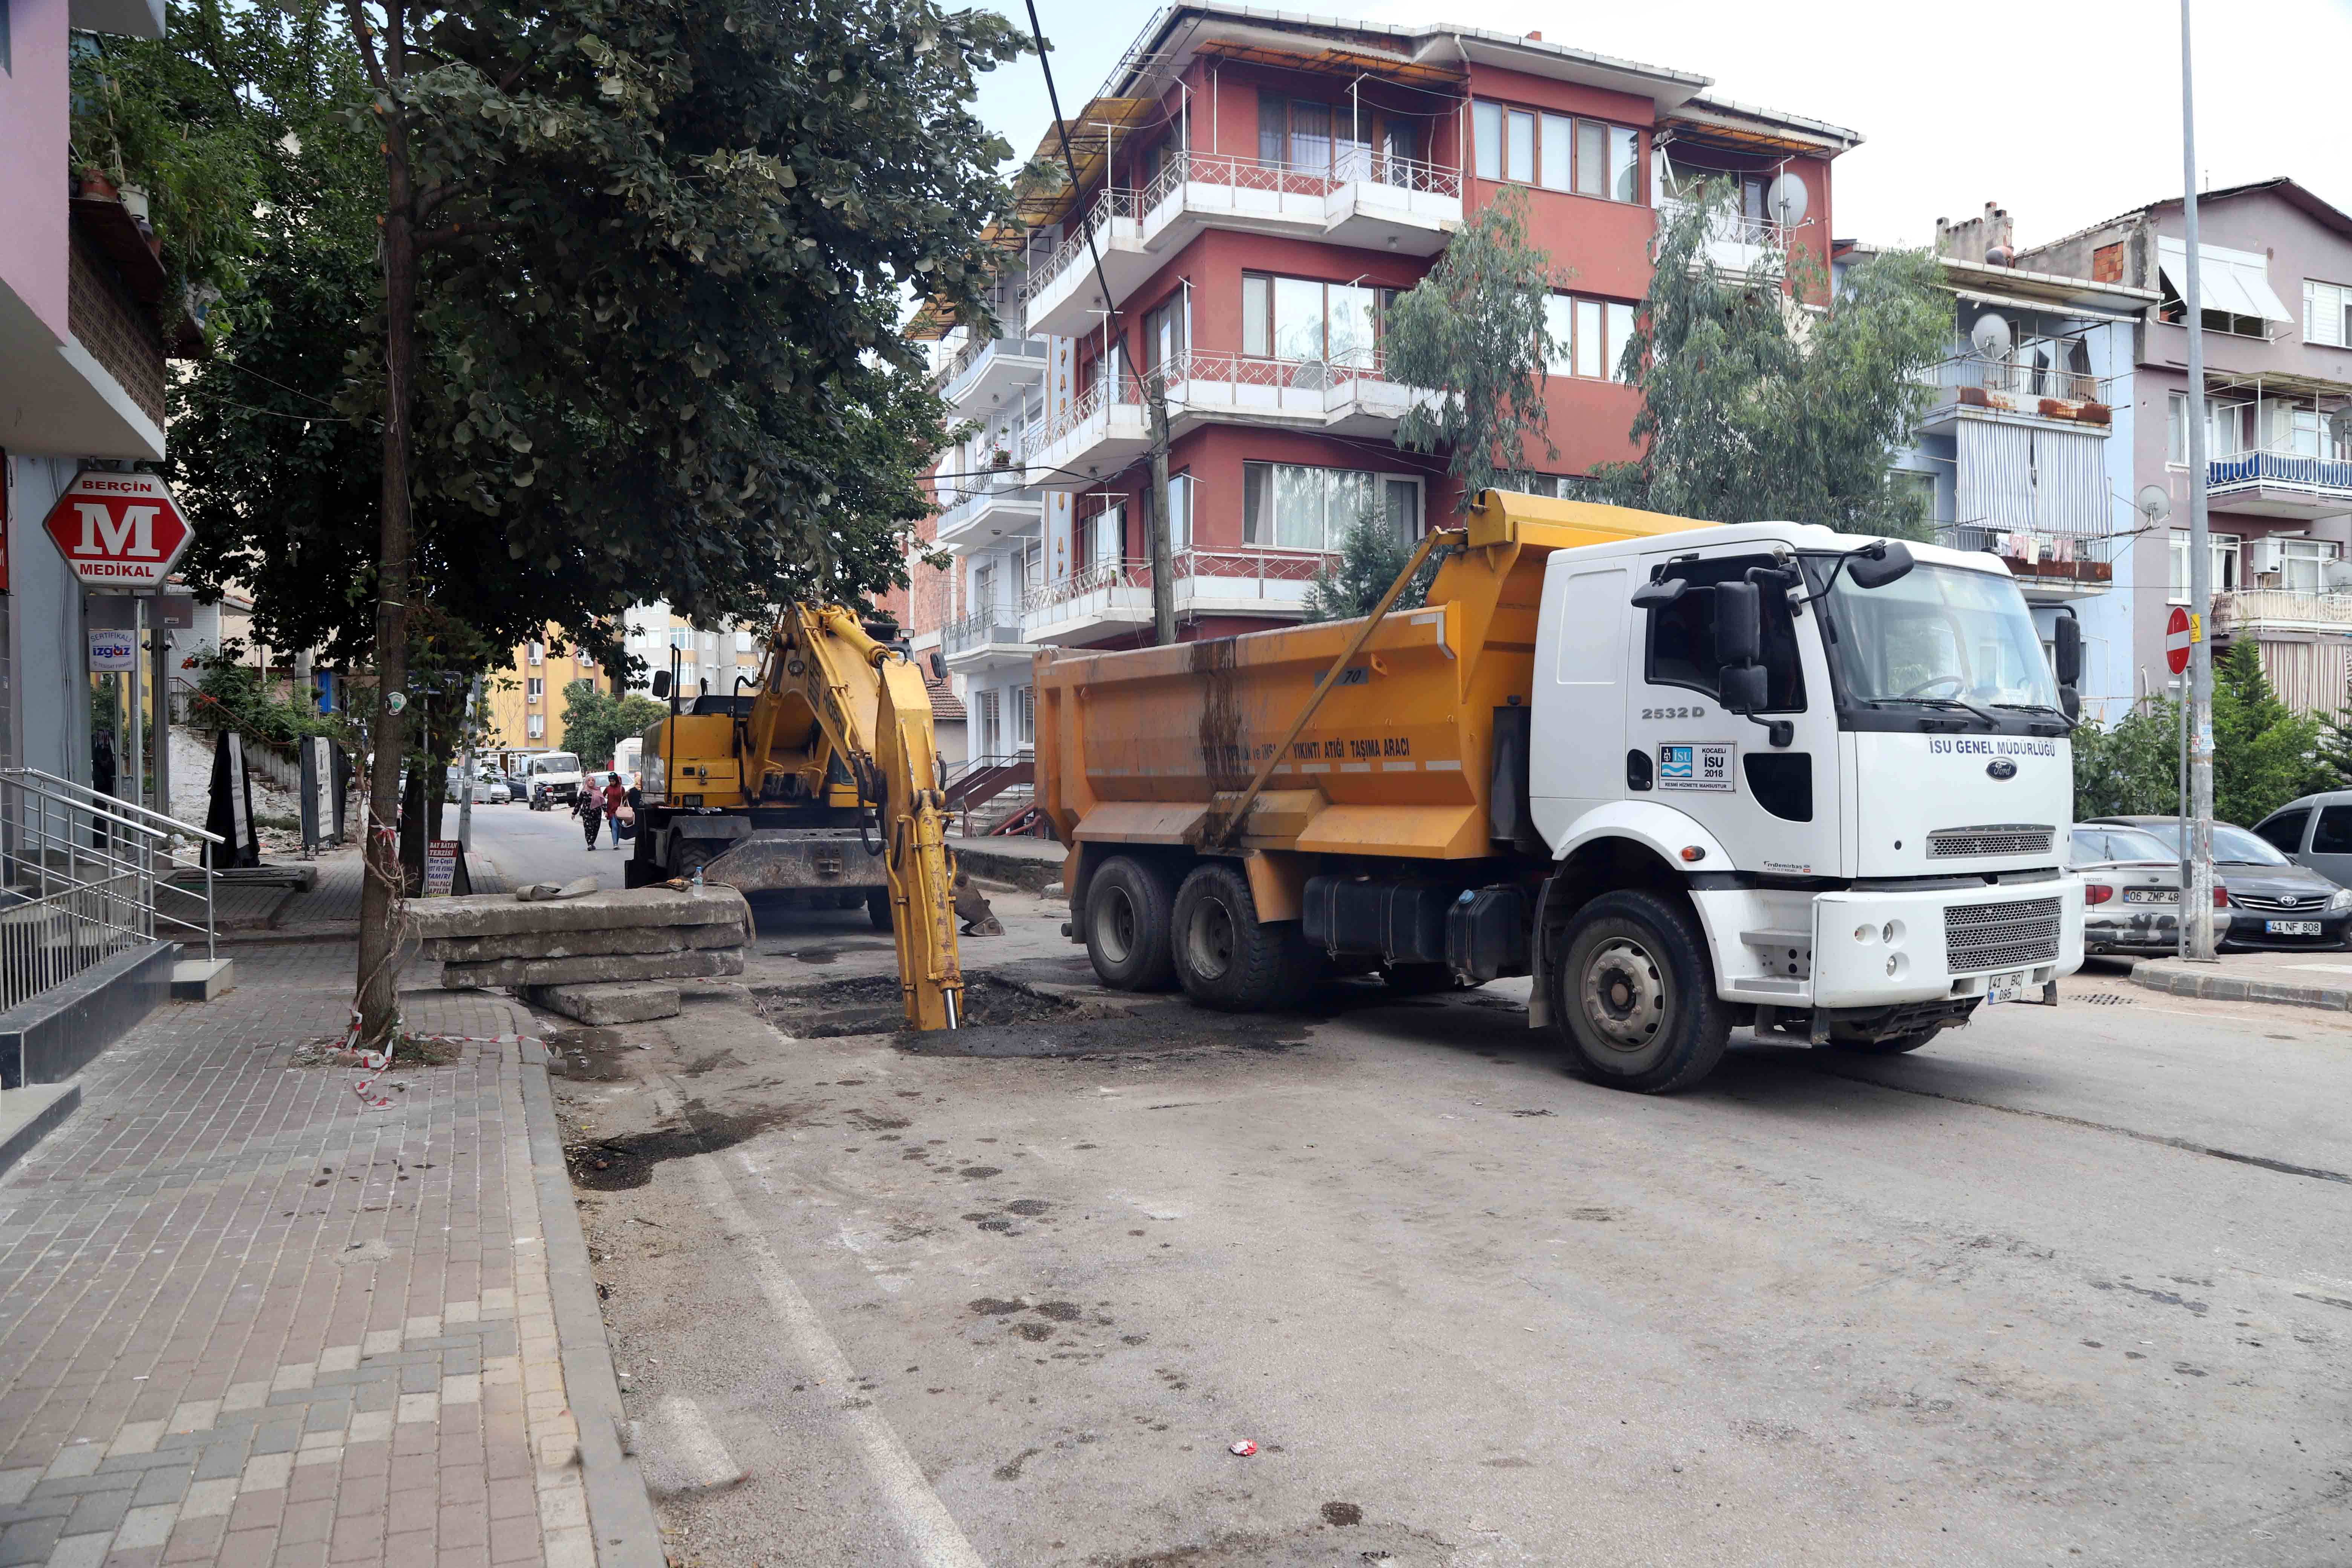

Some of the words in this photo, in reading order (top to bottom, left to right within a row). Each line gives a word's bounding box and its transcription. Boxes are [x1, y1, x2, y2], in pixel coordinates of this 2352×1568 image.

[82, 481, 152, 493] BERÇİN
[74, 502, 160, 557] M
[80, 563, 154, 577] MEDİKAL
[1342, 669, 1361, 684] 70
[1642, 707, 1689, 719] 2532
[1692, 706, 1705, 718] D
[1292, 742, 1320, 759] YIKINTI
[1325, 737, 1344, 758] ATIĞI
[1350, 739, 1381, 761] TAŞIMA
[1384, 738, 1410, 757] ARACI
[1929, 737, 1952, 753] İSU
[1956, 740, 1994, 754] GENEL
[1997, 738, 2055, 756] MÜDÜRLÜĞÜ
[1704, 754, 1724, 767] İSU
[1994, 762, 2011, 775] Ford
[2130, 892, 2141, 901] 06
[2147, 892, 2165, 902] ZMP
[2272, 922, 2282, 931] 41
[2286, 922, 2298, 931] NF
[2303, 923, 2319, 931] 808
[1993, 977, 2001, 988] 41
[2011, 974, 2020, 986] BC
